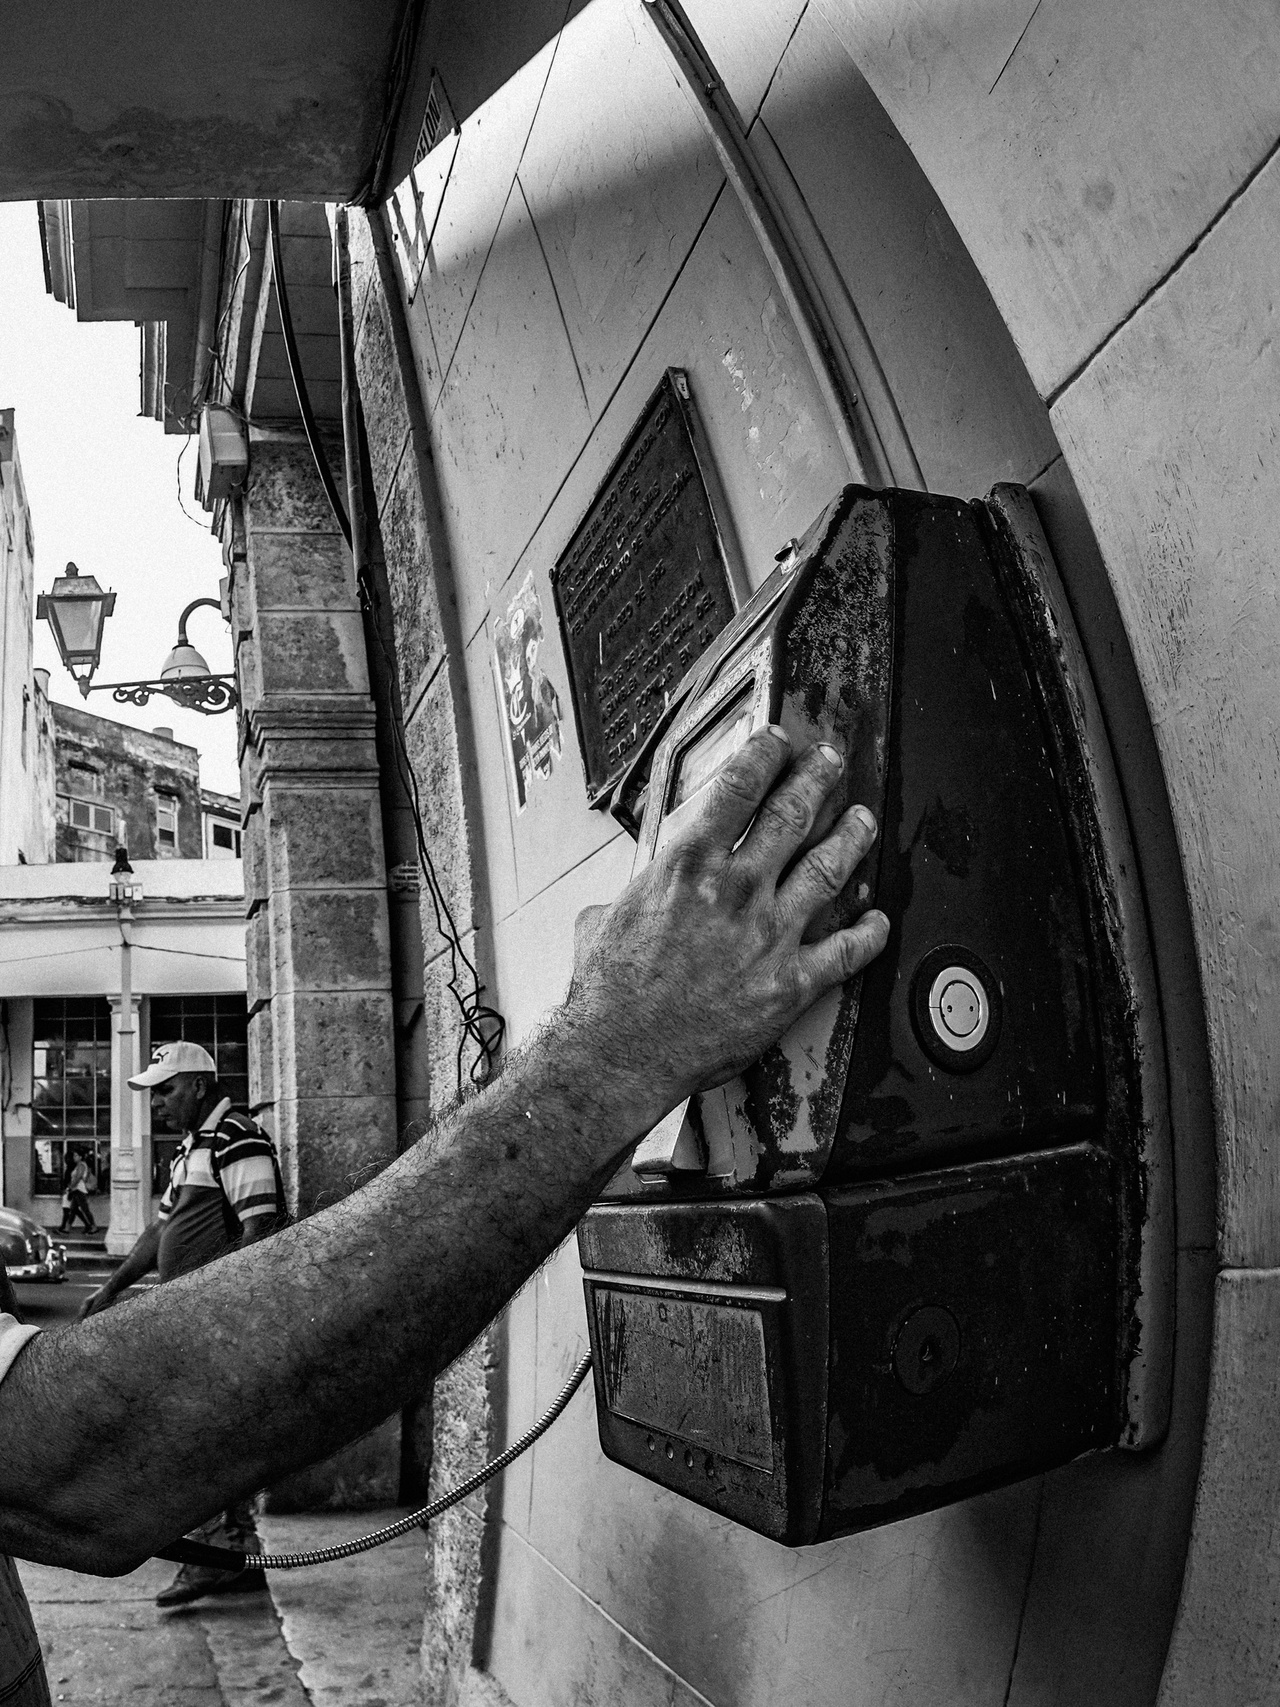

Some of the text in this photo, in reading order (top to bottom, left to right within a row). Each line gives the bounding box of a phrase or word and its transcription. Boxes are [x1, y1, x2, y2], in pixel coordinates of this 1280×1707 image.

[558, 556, 573, 588] ESTA
[572, 527, 591, 566] CALLE
[590, 511, 601, 538] HA
[600, 485, 617, 522] SIDO
[617, 424, 656, 494] REMOZADA
[565, 477, 660, 625] INSTITUCIONES CATALANAS
[574, 501, 624, 589] CONTRIBUCION
[628, 477, 640, 504] DE
[582, 546, 631, 625] AYUNTAMIENTO
[630, 530, 644, 558] DE
[643, 459, 693, 540] BARCELONA
[600, 587, 716, 724] ASAMBLEA PROVINCIAL DEL
[605, 597, 634, 644] MARZO
[634, 582, 646, 608] DE
[624, 648, 636, 673] DE
[648, 569, 704, 645] REVOLUCION
[603, 706, 629, 745] PODER
[678, 641, 693, 667] EN
[698, 620, 713, 647] LA
[639, 711, 653, 736] DE
